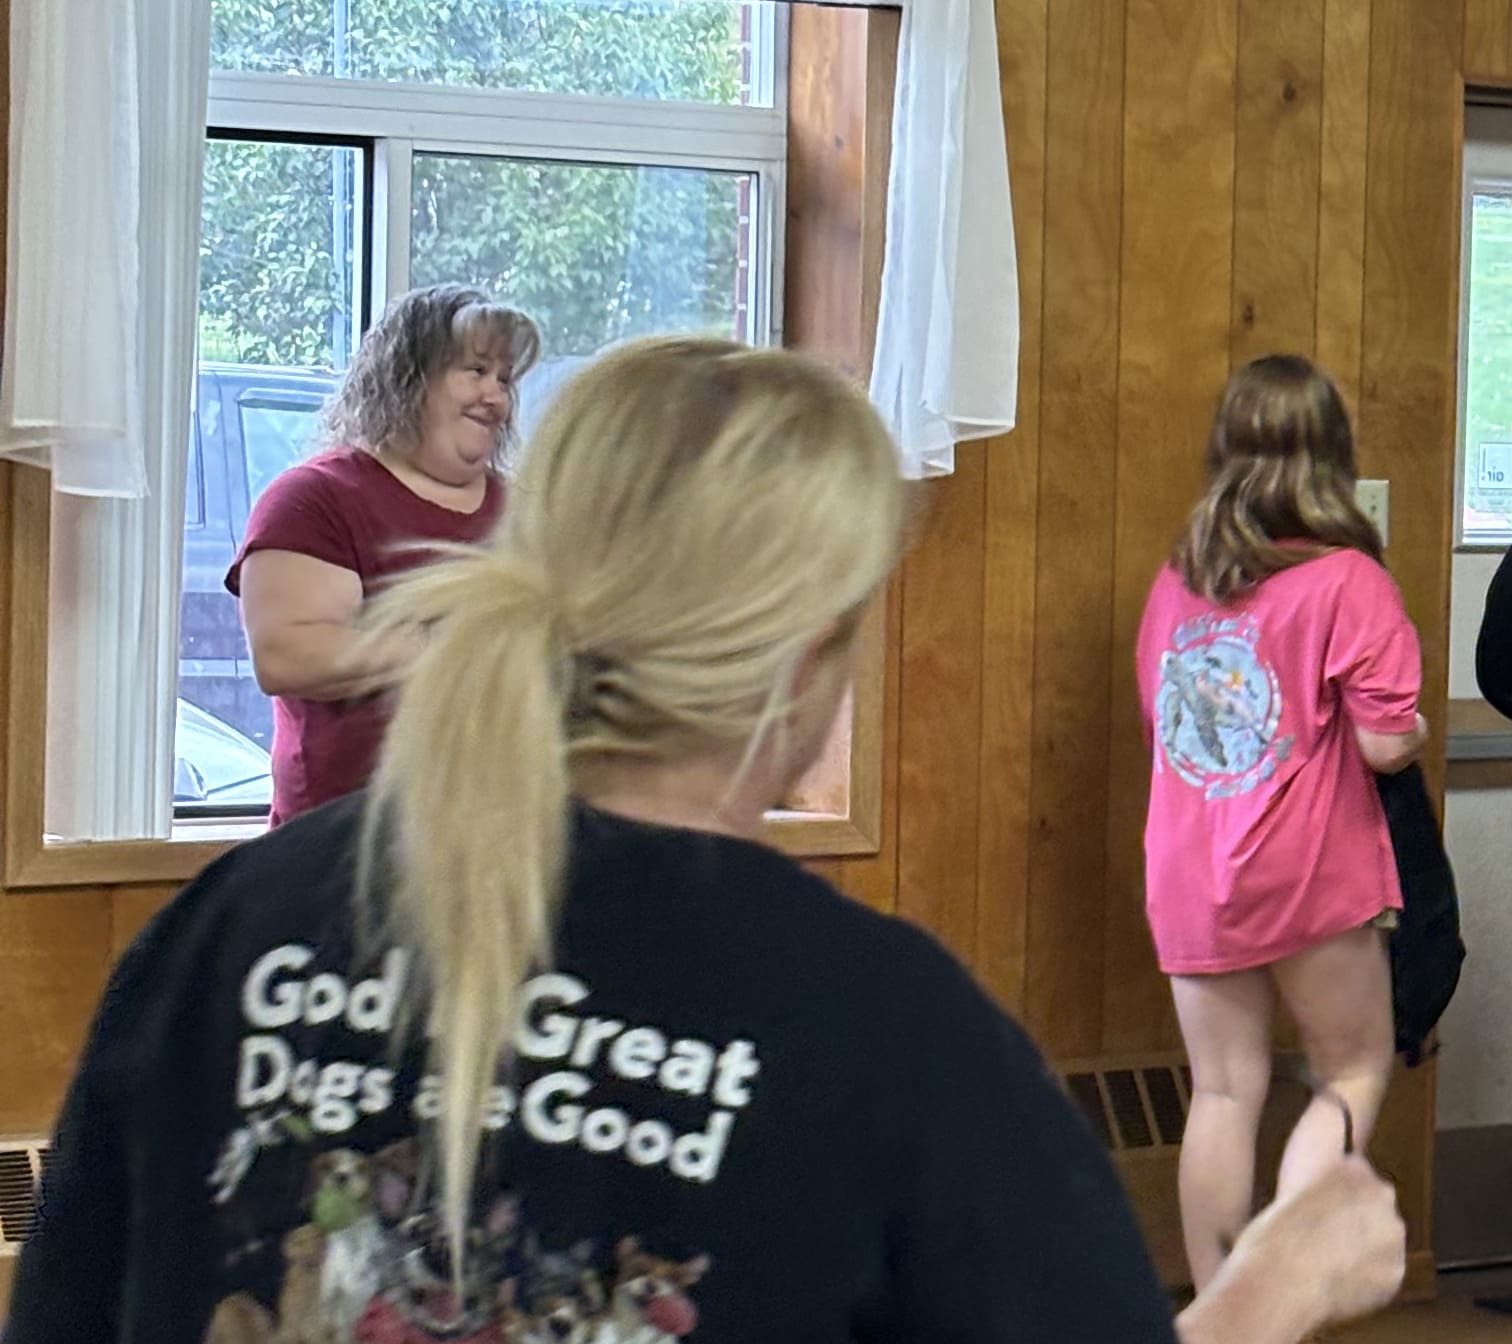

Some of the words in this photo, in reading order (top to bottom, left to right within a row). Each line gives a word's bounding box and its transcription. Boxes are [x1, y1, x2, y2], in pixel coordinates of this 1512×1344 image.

[242, 943, 408, 1033] God
[514, 972, 761, 1108] Great
[237, 1034, 396, 1133] Dogs
[412, 1073, 517, 1131] ae
[521, 1070, 735, 1185] Good
